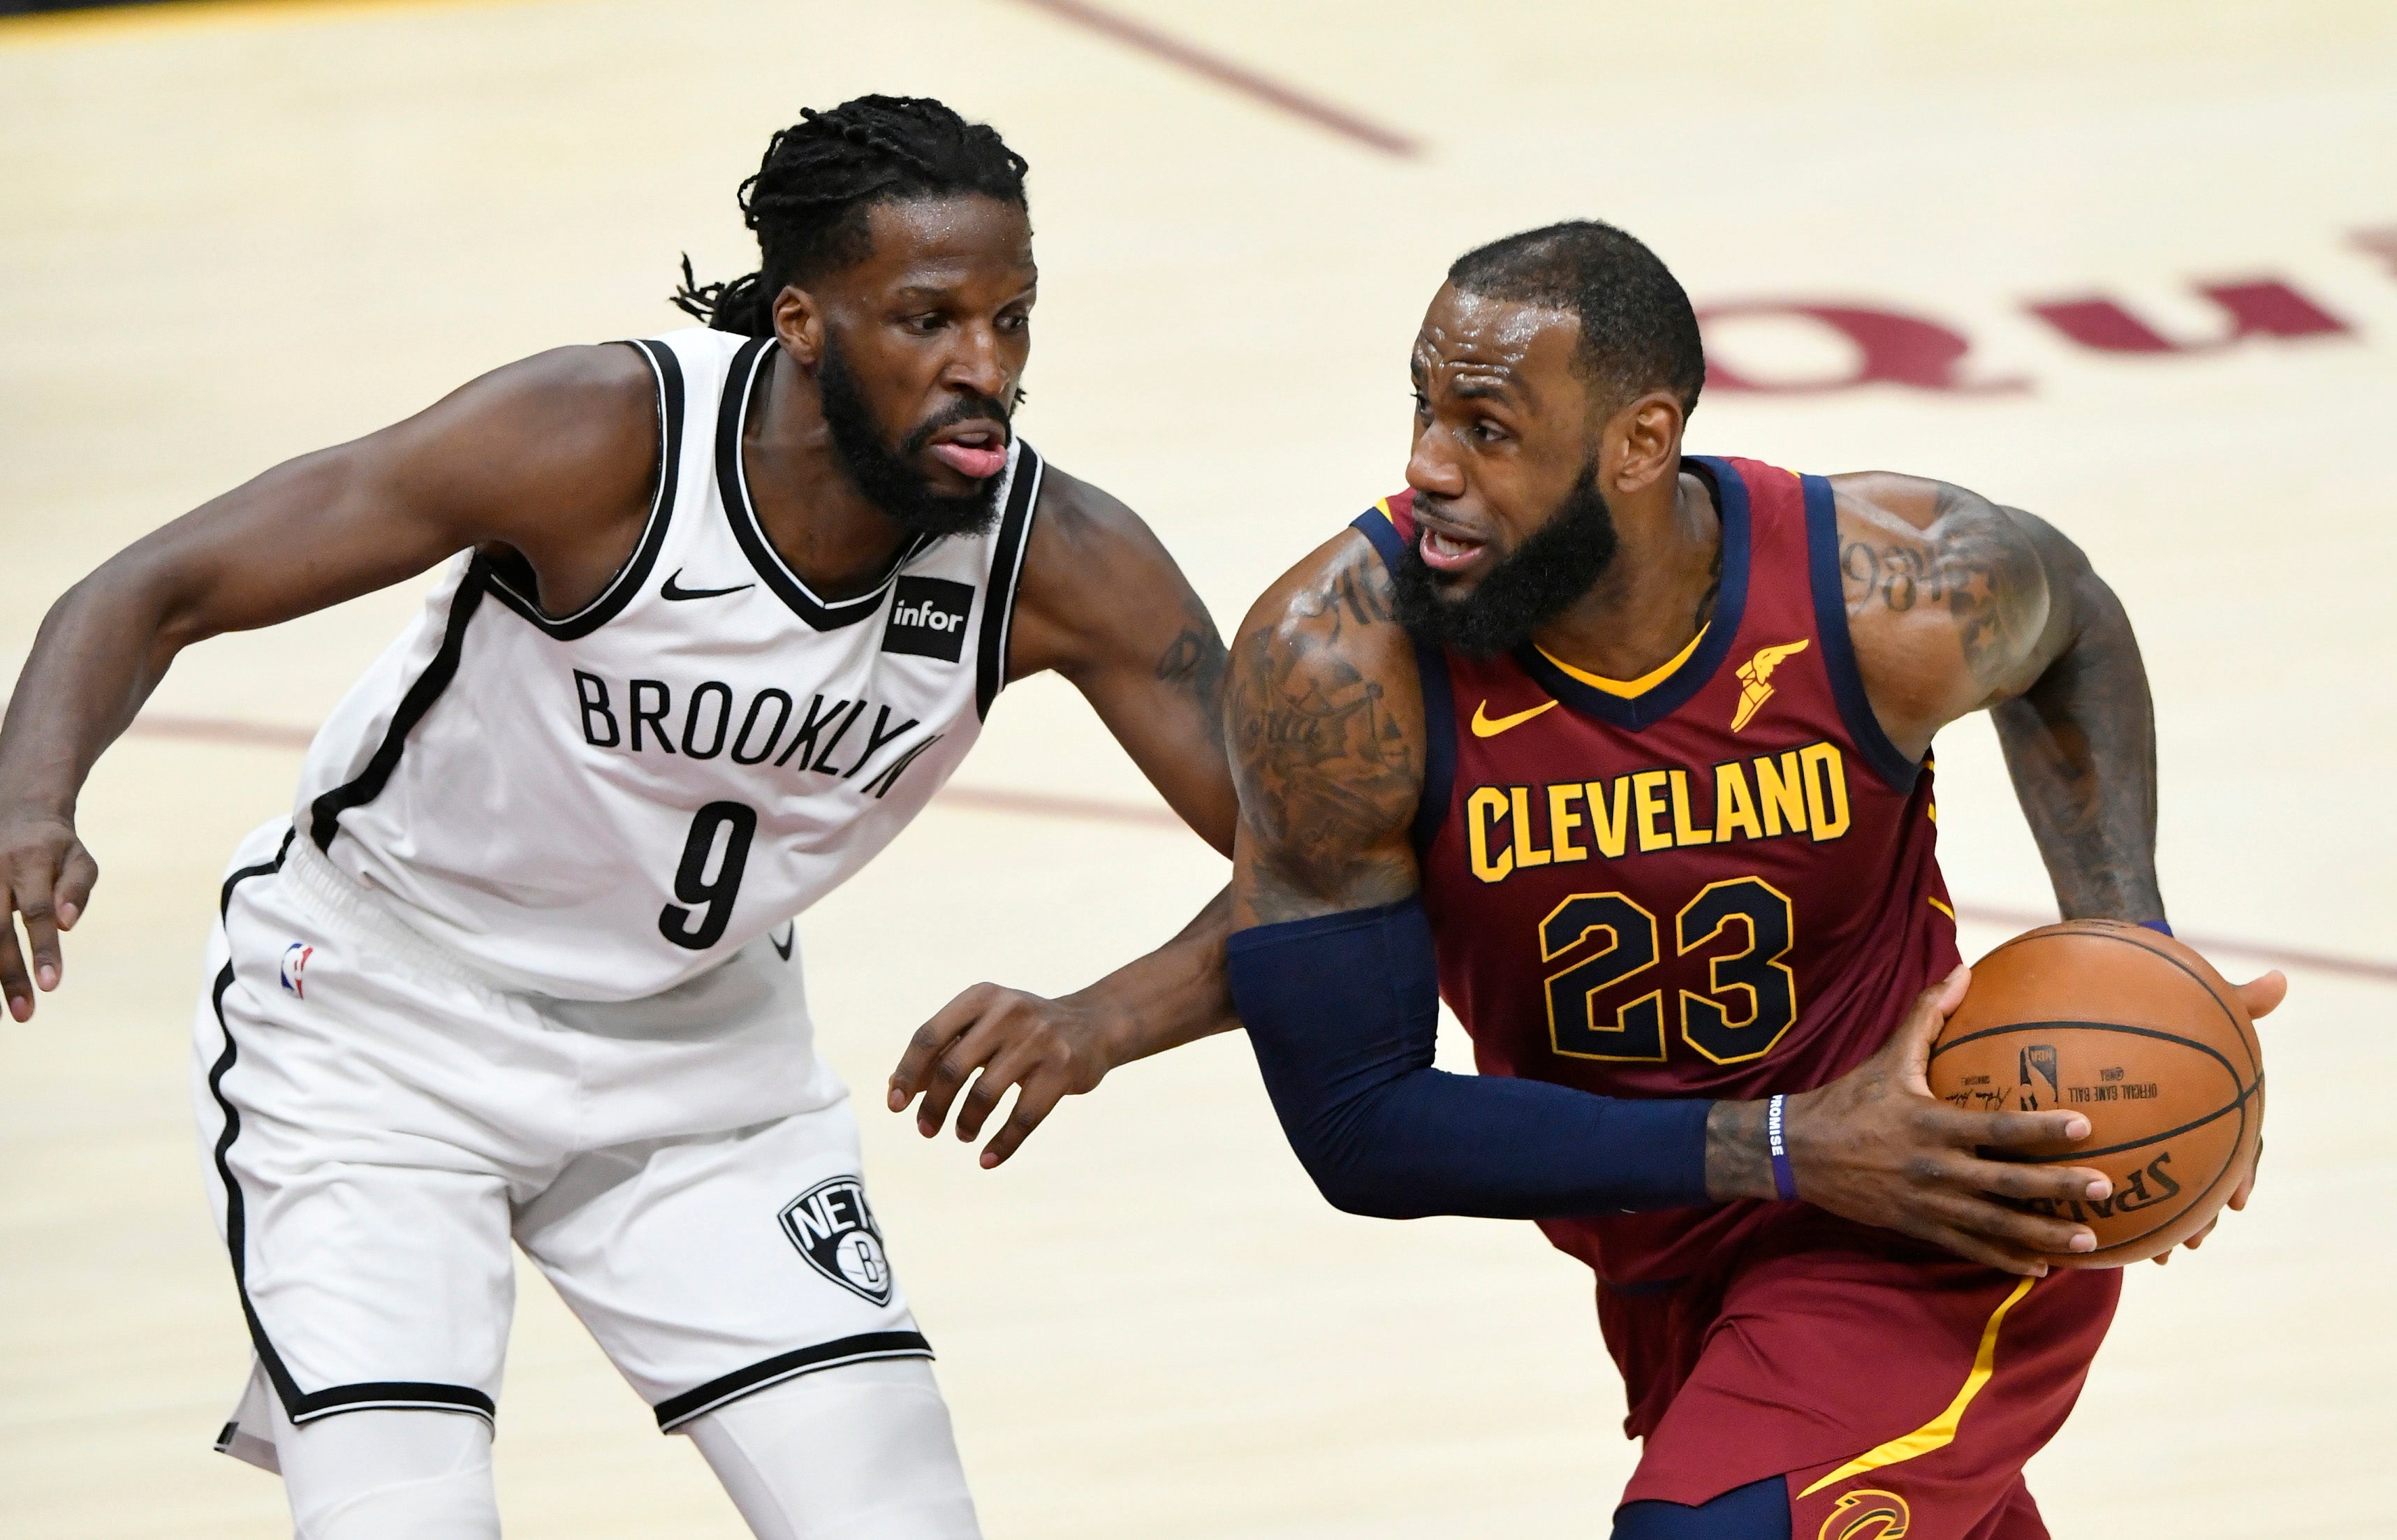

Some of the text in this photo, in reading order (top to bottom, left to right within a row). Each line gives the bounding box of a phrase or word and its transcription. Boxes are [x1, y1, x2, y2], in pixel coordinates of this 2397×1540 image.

[1697, 229, 2397, 395] Qu
[893, 599, 964, 633] infor
[573, 668, 945, 799] BROOKLYN
[658, 800, 758, 951] 9
[1465, 740, 1852, 883] CLEVELAND
[1538, 875, 1798, 1065] 23
[2068, 1083, 2157, 1103] OFFICIAL GAME BALL
[791, 1182, 870, 1251] NET
